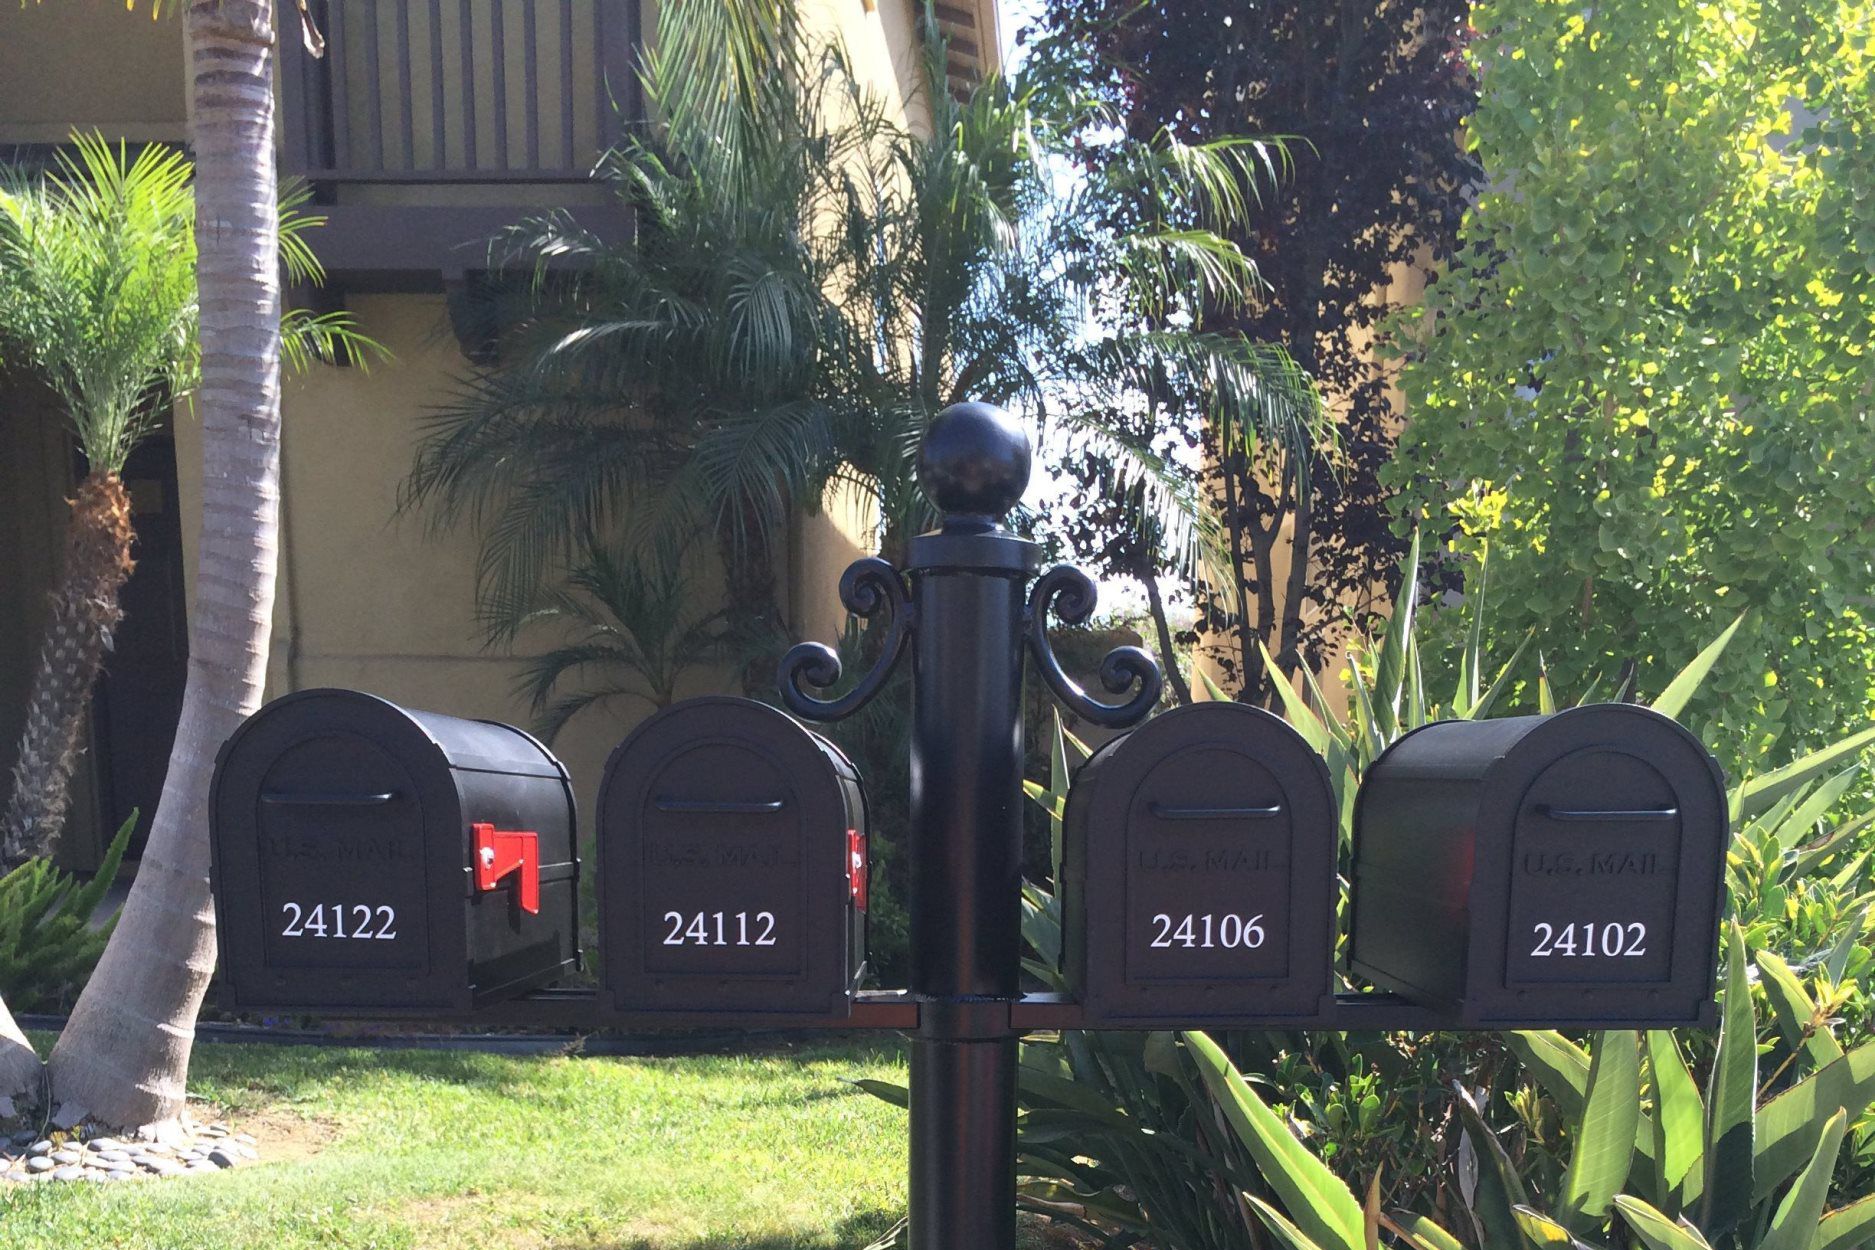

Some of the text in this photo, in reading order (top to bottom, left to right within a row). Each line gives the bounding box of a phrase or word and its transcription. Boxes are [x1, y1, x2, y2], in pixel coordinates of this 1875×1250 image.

[1138, 848, 1285, 873] U.S. MAIL
[1522, 852, 1670, 877] U.S. MAIL
[281, 902, 397, 940] 24122
[662, 911, 777, 946] 24112
[1150, 913, 1265, 949] 24106
[1530, 922, 1647, 957] 24102
